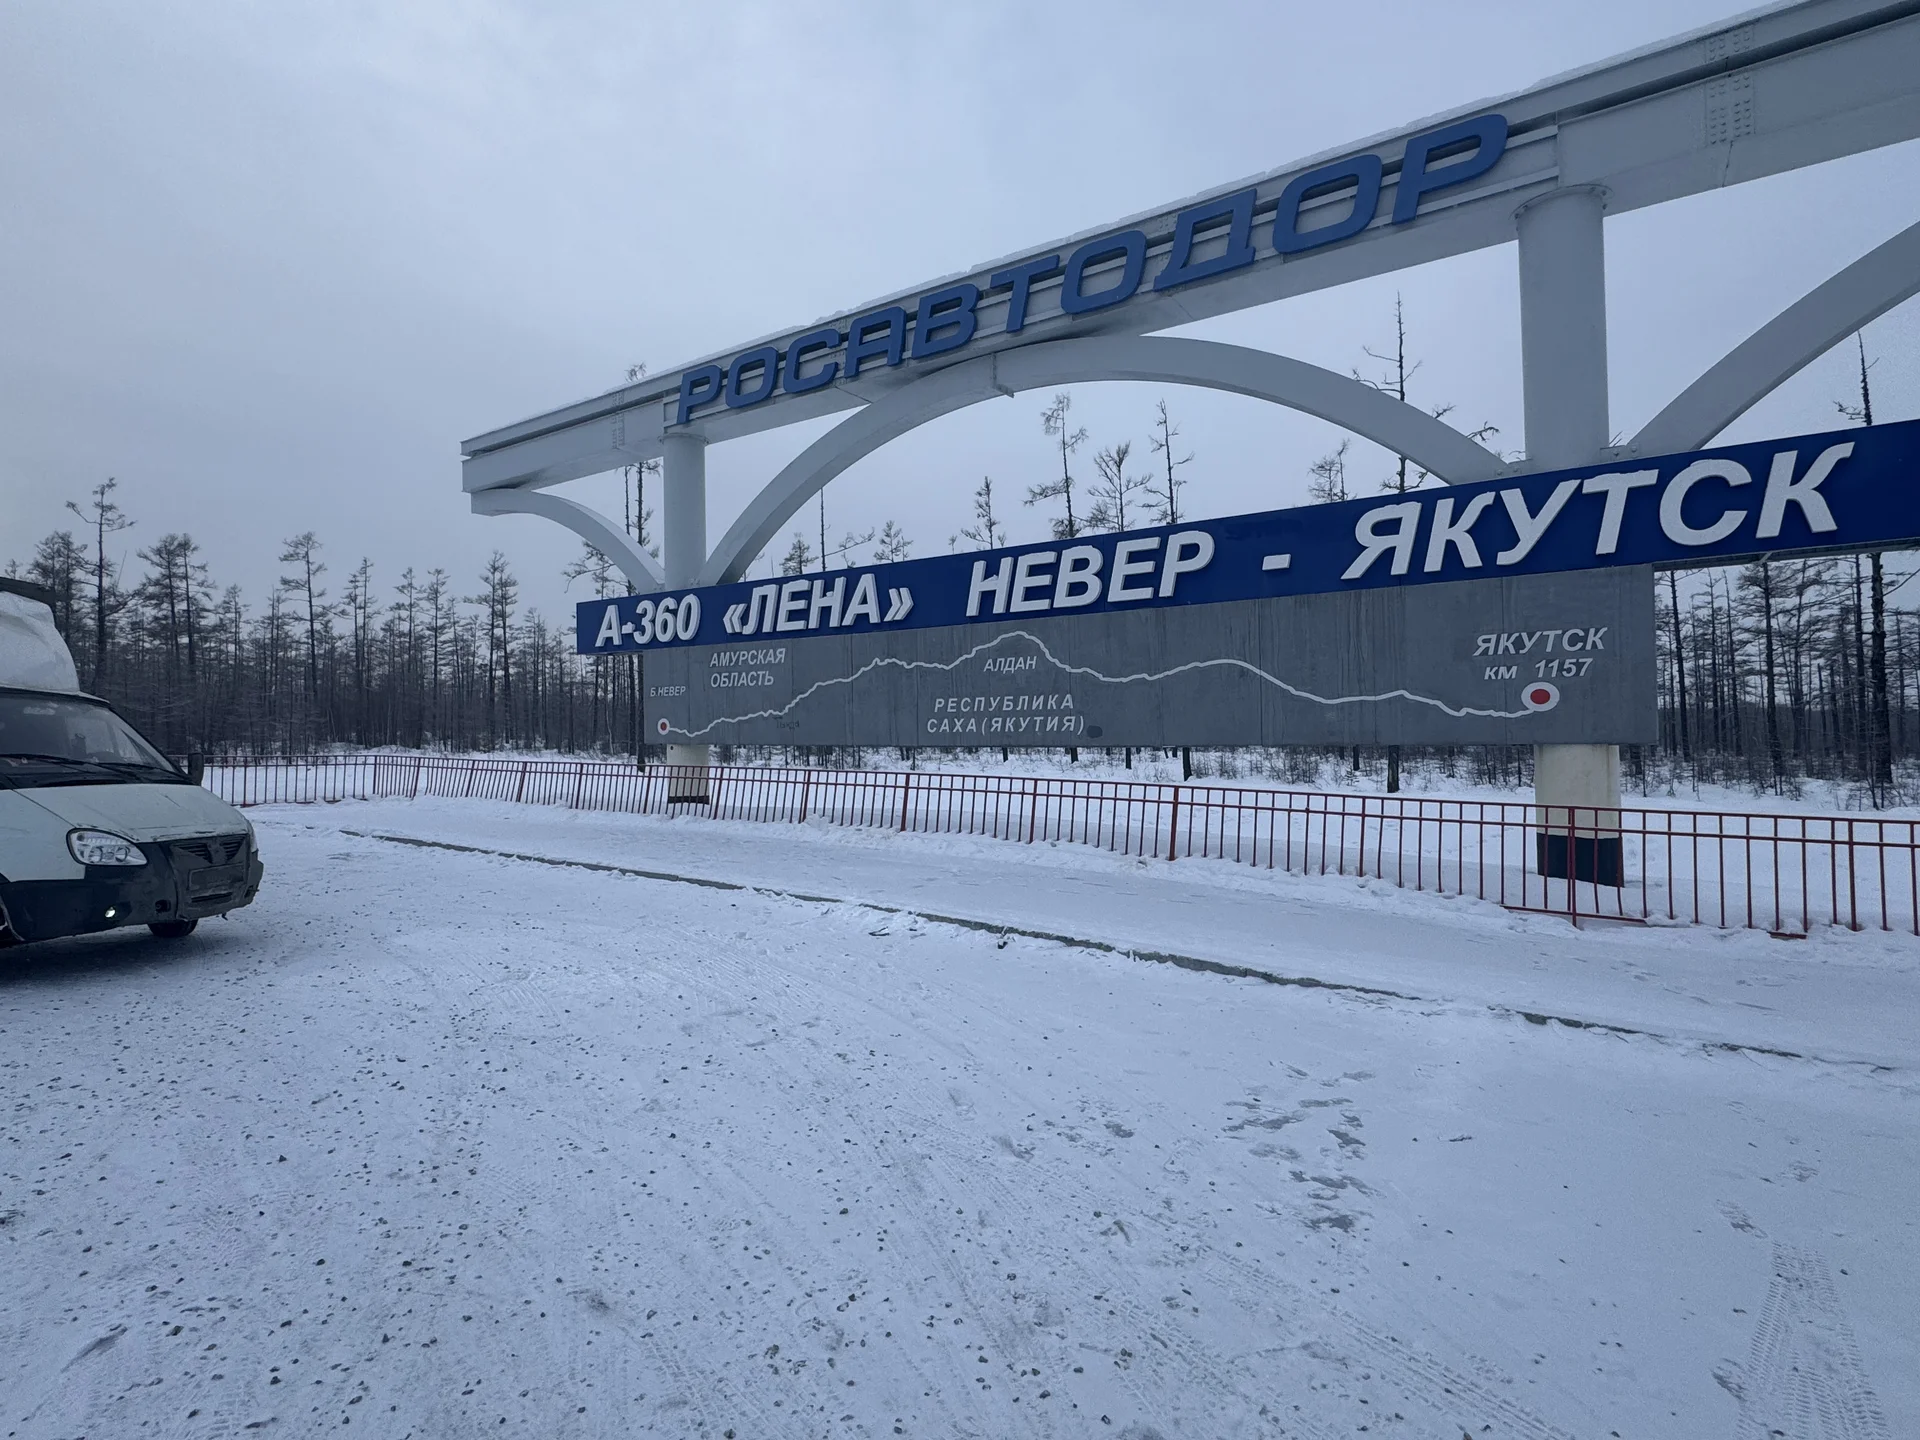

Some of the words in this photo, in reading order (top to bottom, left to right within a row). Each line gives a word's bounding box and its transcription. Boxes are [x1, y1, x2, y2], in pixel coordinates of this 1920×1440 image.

[676, 114, 1509, 425] РОСАВТОДОР
[595, 593, 701, 647] А-360
[722, 573, 914, 635] «ЛЕНА»
[965, 530, 1216, 617] НЕВЕР
[1262, 553, 1292, 571] -
[1340, 441, 1856, 580] ЯКУТСК
[1472, 627, 1608, 657] ЯКУТСК
[709, 648, 786, 668] АМУРСКАЯ
[983, 656, 1037, 674] АЛДАН
[1535, 658, 1593, 678] 1157
[710, 671, 775, 688] ОБЛАСТЬ
[934, 694, 1074, 713] РЕСПУБЛИКА
